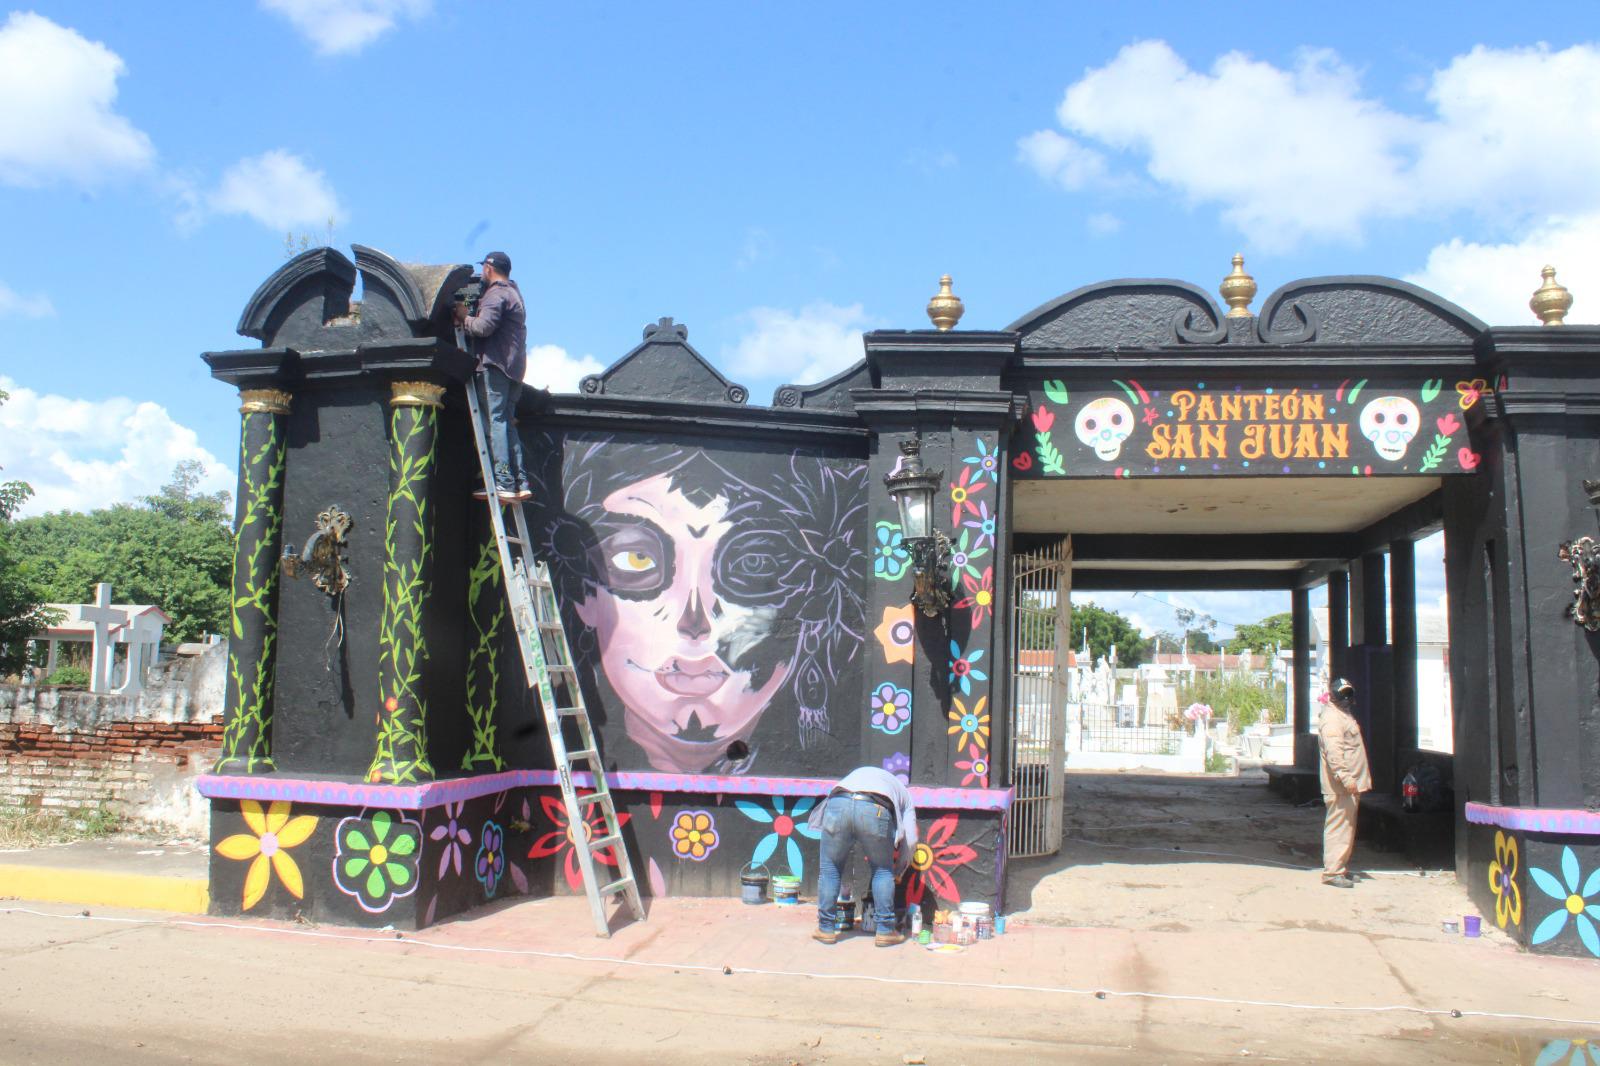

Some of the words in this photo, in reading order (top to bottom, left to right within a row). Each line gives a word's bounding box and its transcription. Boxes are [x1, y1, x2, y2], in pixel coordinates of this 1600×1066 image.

[1170, 388, 1324, 422] PANTEÓN
[1144, 423, 1228, 460] SAN
[1239, 423, 1350, 460] JUAN
